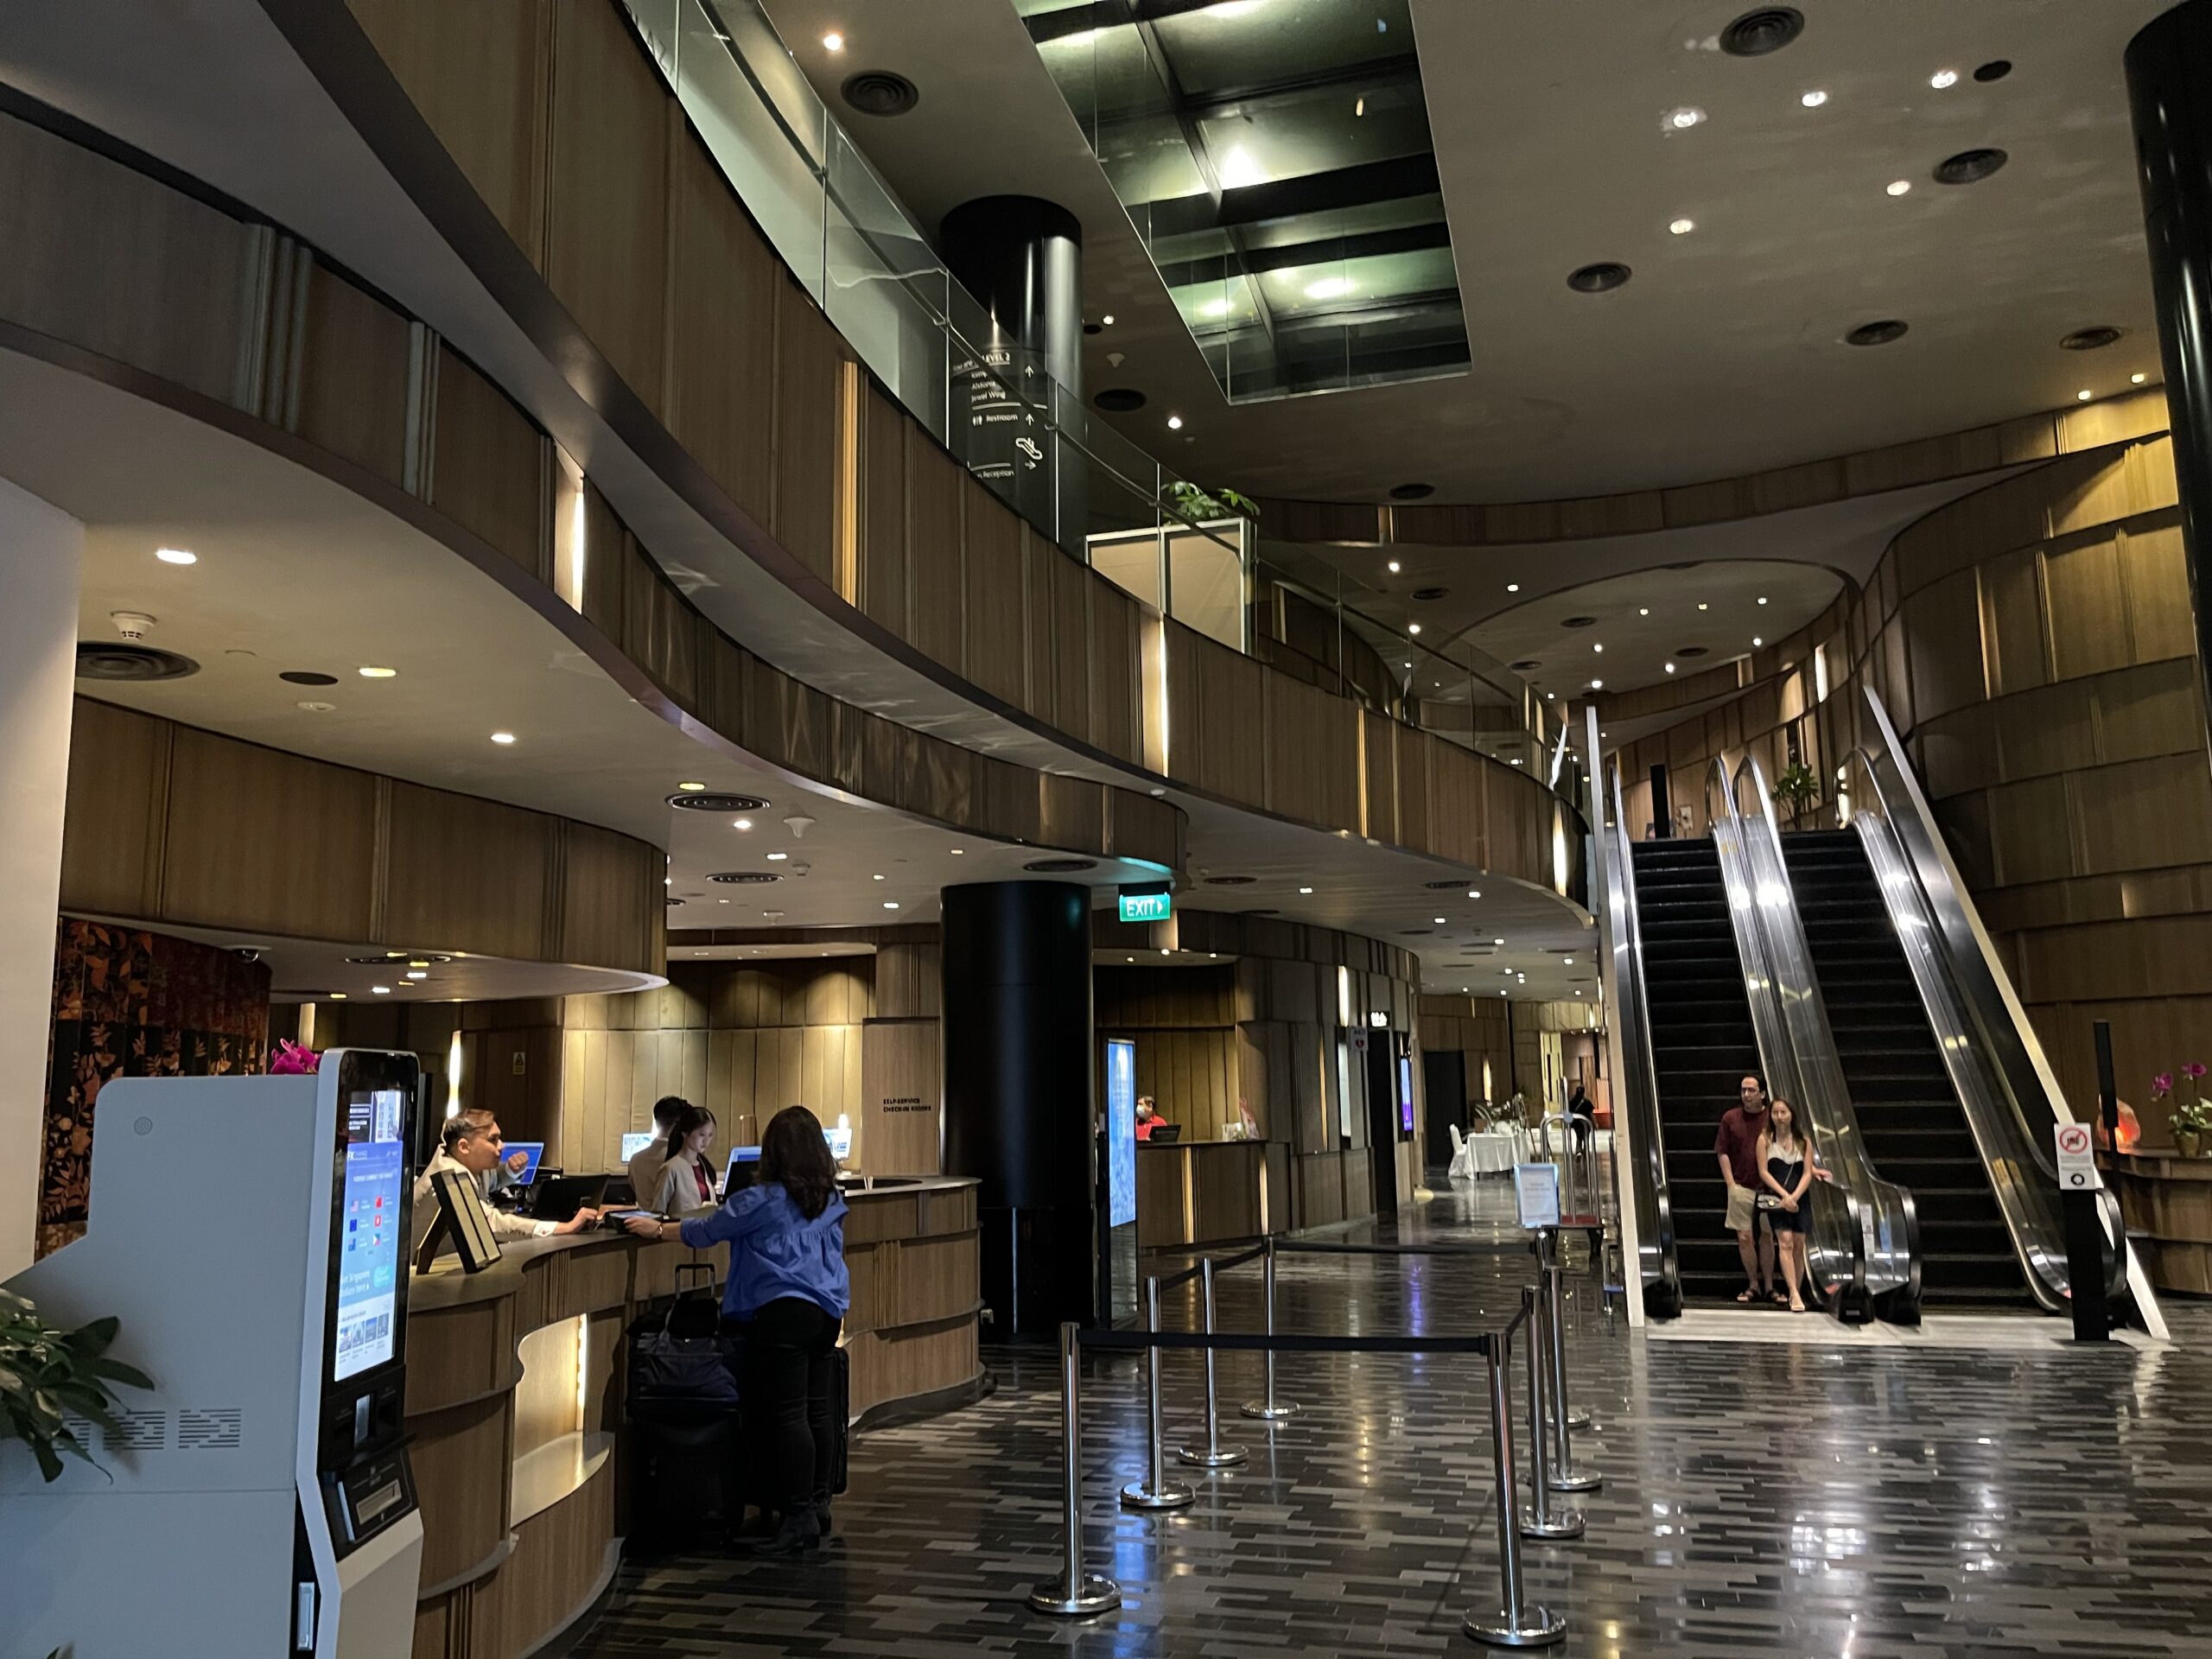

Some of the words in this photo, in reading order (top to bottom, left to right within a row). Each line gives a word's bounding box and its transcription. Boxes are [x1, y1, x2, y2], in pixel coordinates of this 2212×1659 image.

[988, 390, 1007, 400] Wing
[986, 414, 1019, 423] Restroom
[982, 469, 1014, 479] Reception
[1126, 899, 1155, 917] EXIT
